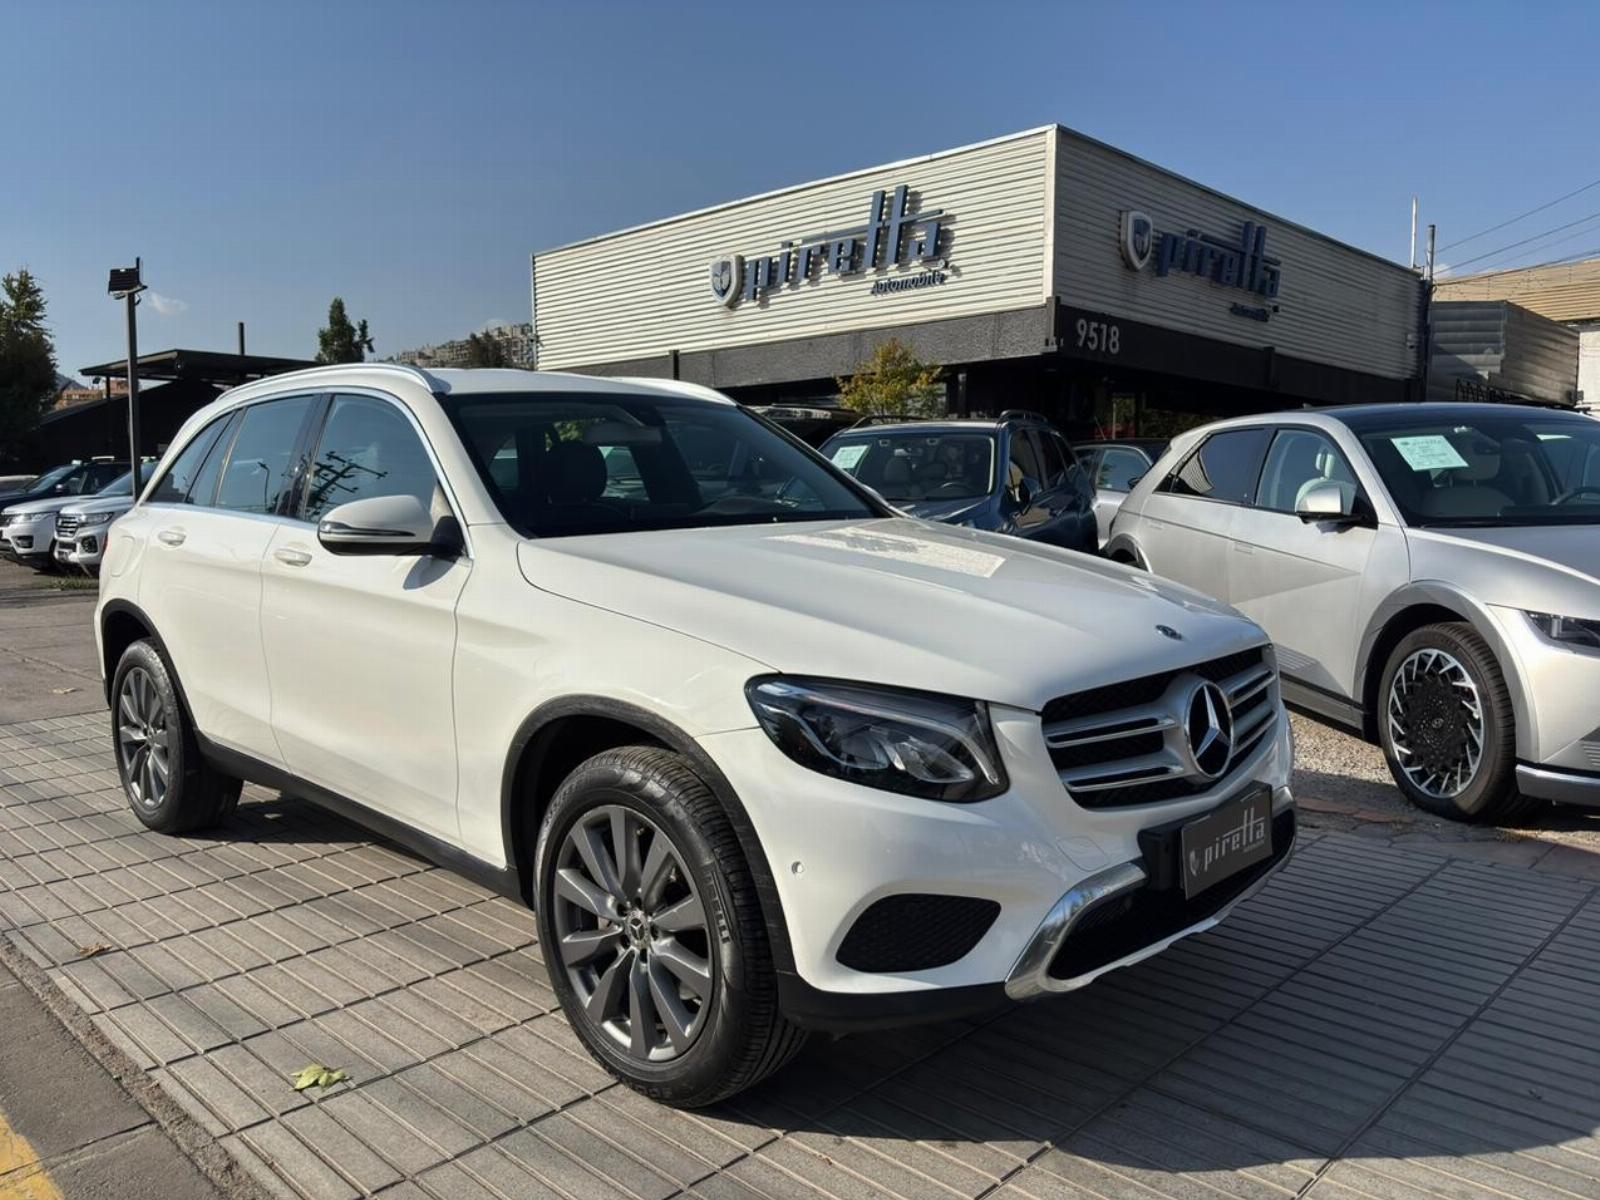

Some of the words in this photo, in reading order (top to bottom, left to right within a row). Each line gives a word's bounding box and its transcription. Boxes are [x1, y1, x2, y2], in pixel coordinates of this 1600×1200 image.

[744, 184, 944, 301] piretta
[1077, 318, 1120, 355] 9518
[1204, 807, 1265, 872] piretta
